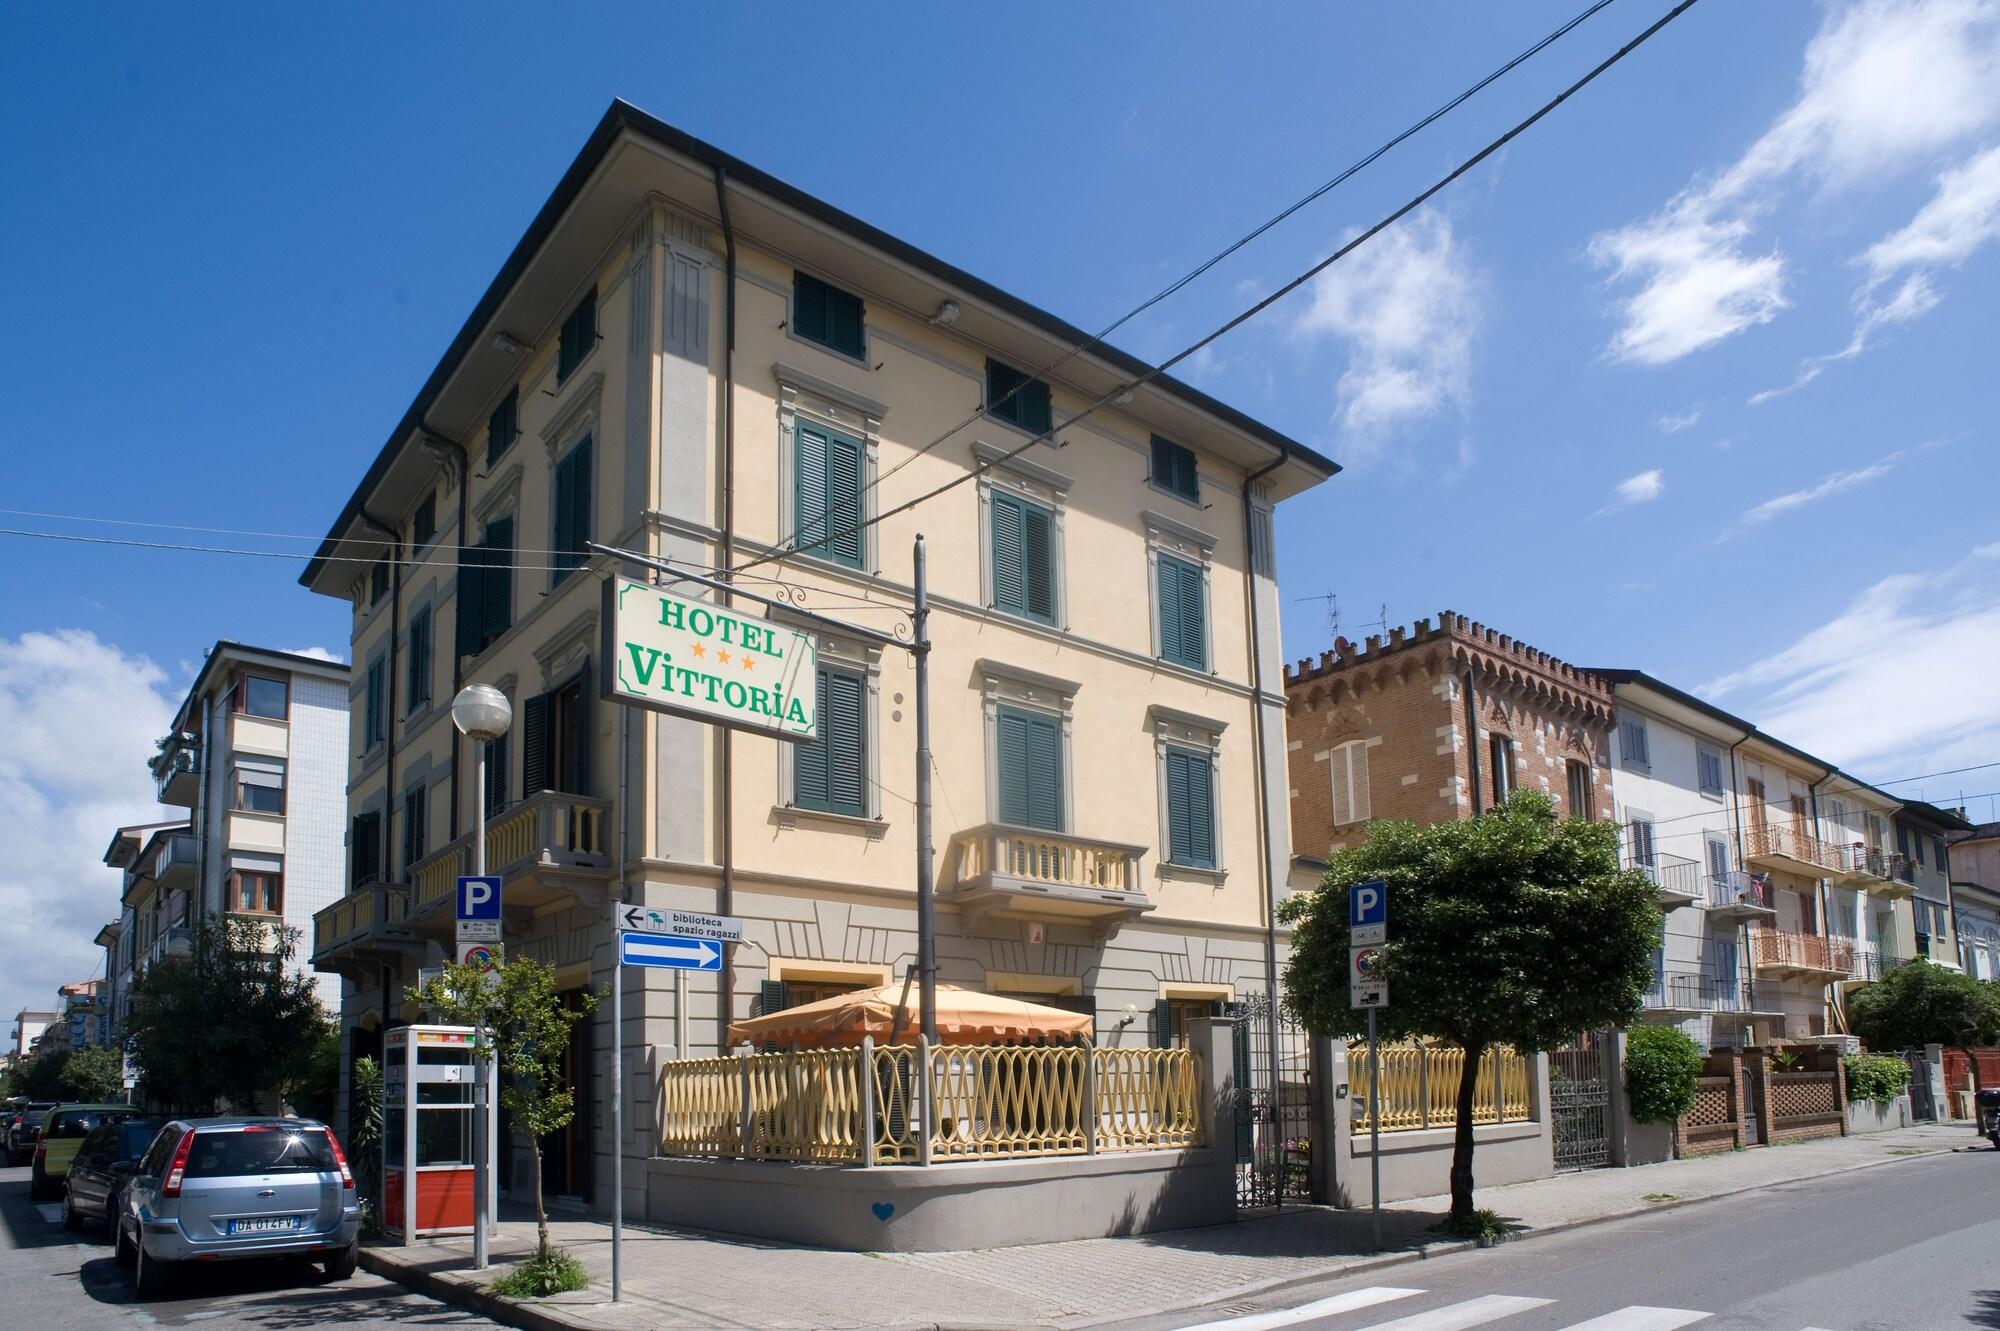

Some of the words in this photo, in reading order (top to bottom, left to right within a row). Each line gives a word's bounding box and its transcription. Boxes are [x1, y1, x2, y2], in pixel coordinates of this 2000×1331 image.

[658, 598, 783, 658] HOTEL
[465, 881, 492, 916] P
[1357, 888, 1377, 921] P
[673, 912, 722, 927] biblioteca
[672, 924, 704, 937] spazio
[706, 928, 740, 940] ragazzi
[238, 1220, 252, 1231] DA
